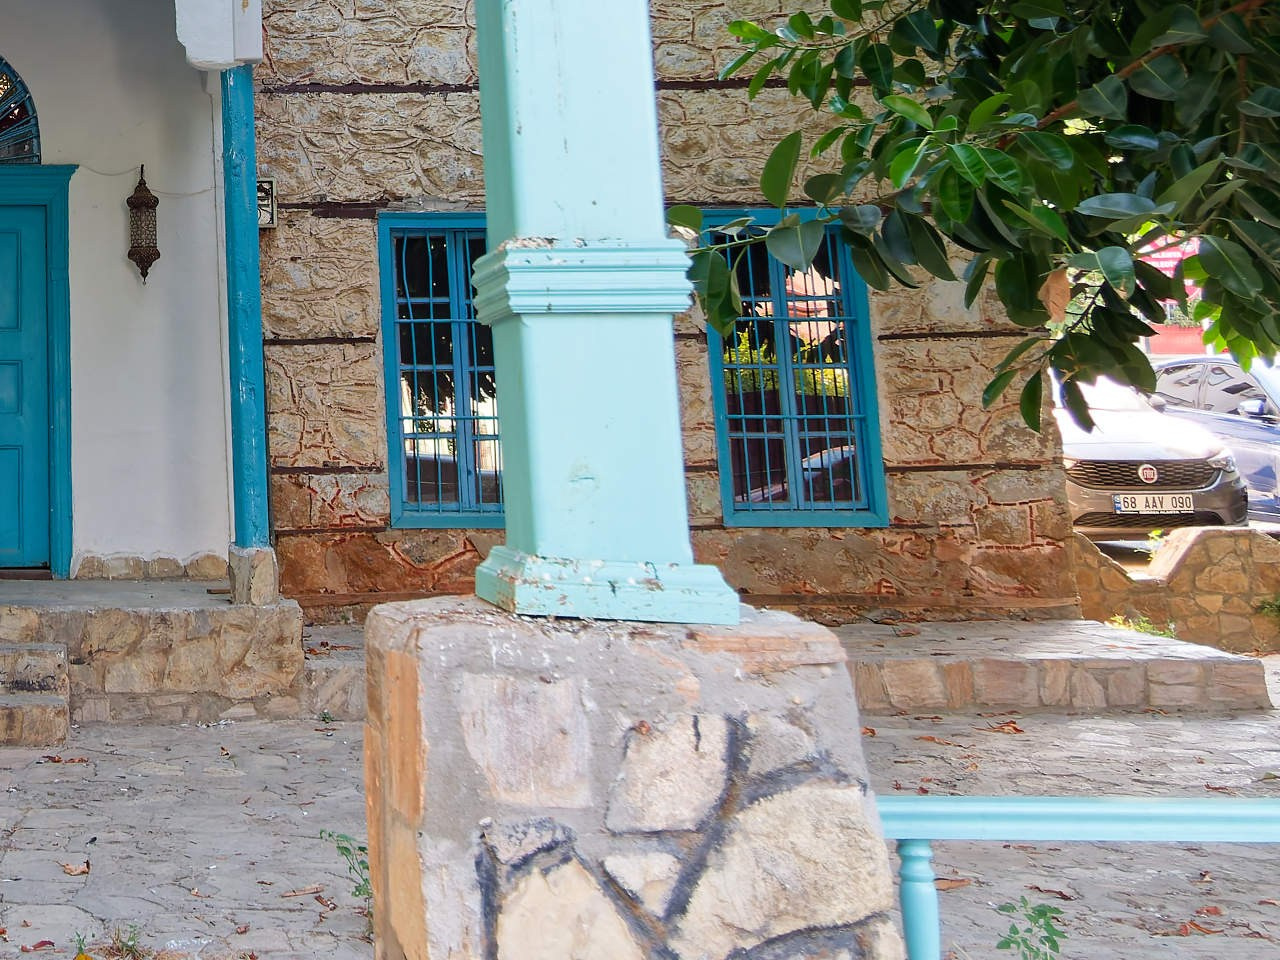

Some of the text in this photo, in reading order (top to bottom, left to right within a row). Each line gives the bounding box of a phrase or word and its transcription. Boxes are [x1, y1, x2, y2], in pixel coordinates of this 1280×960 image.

[1123, 496, 1191, 509] 68 AAV 090
